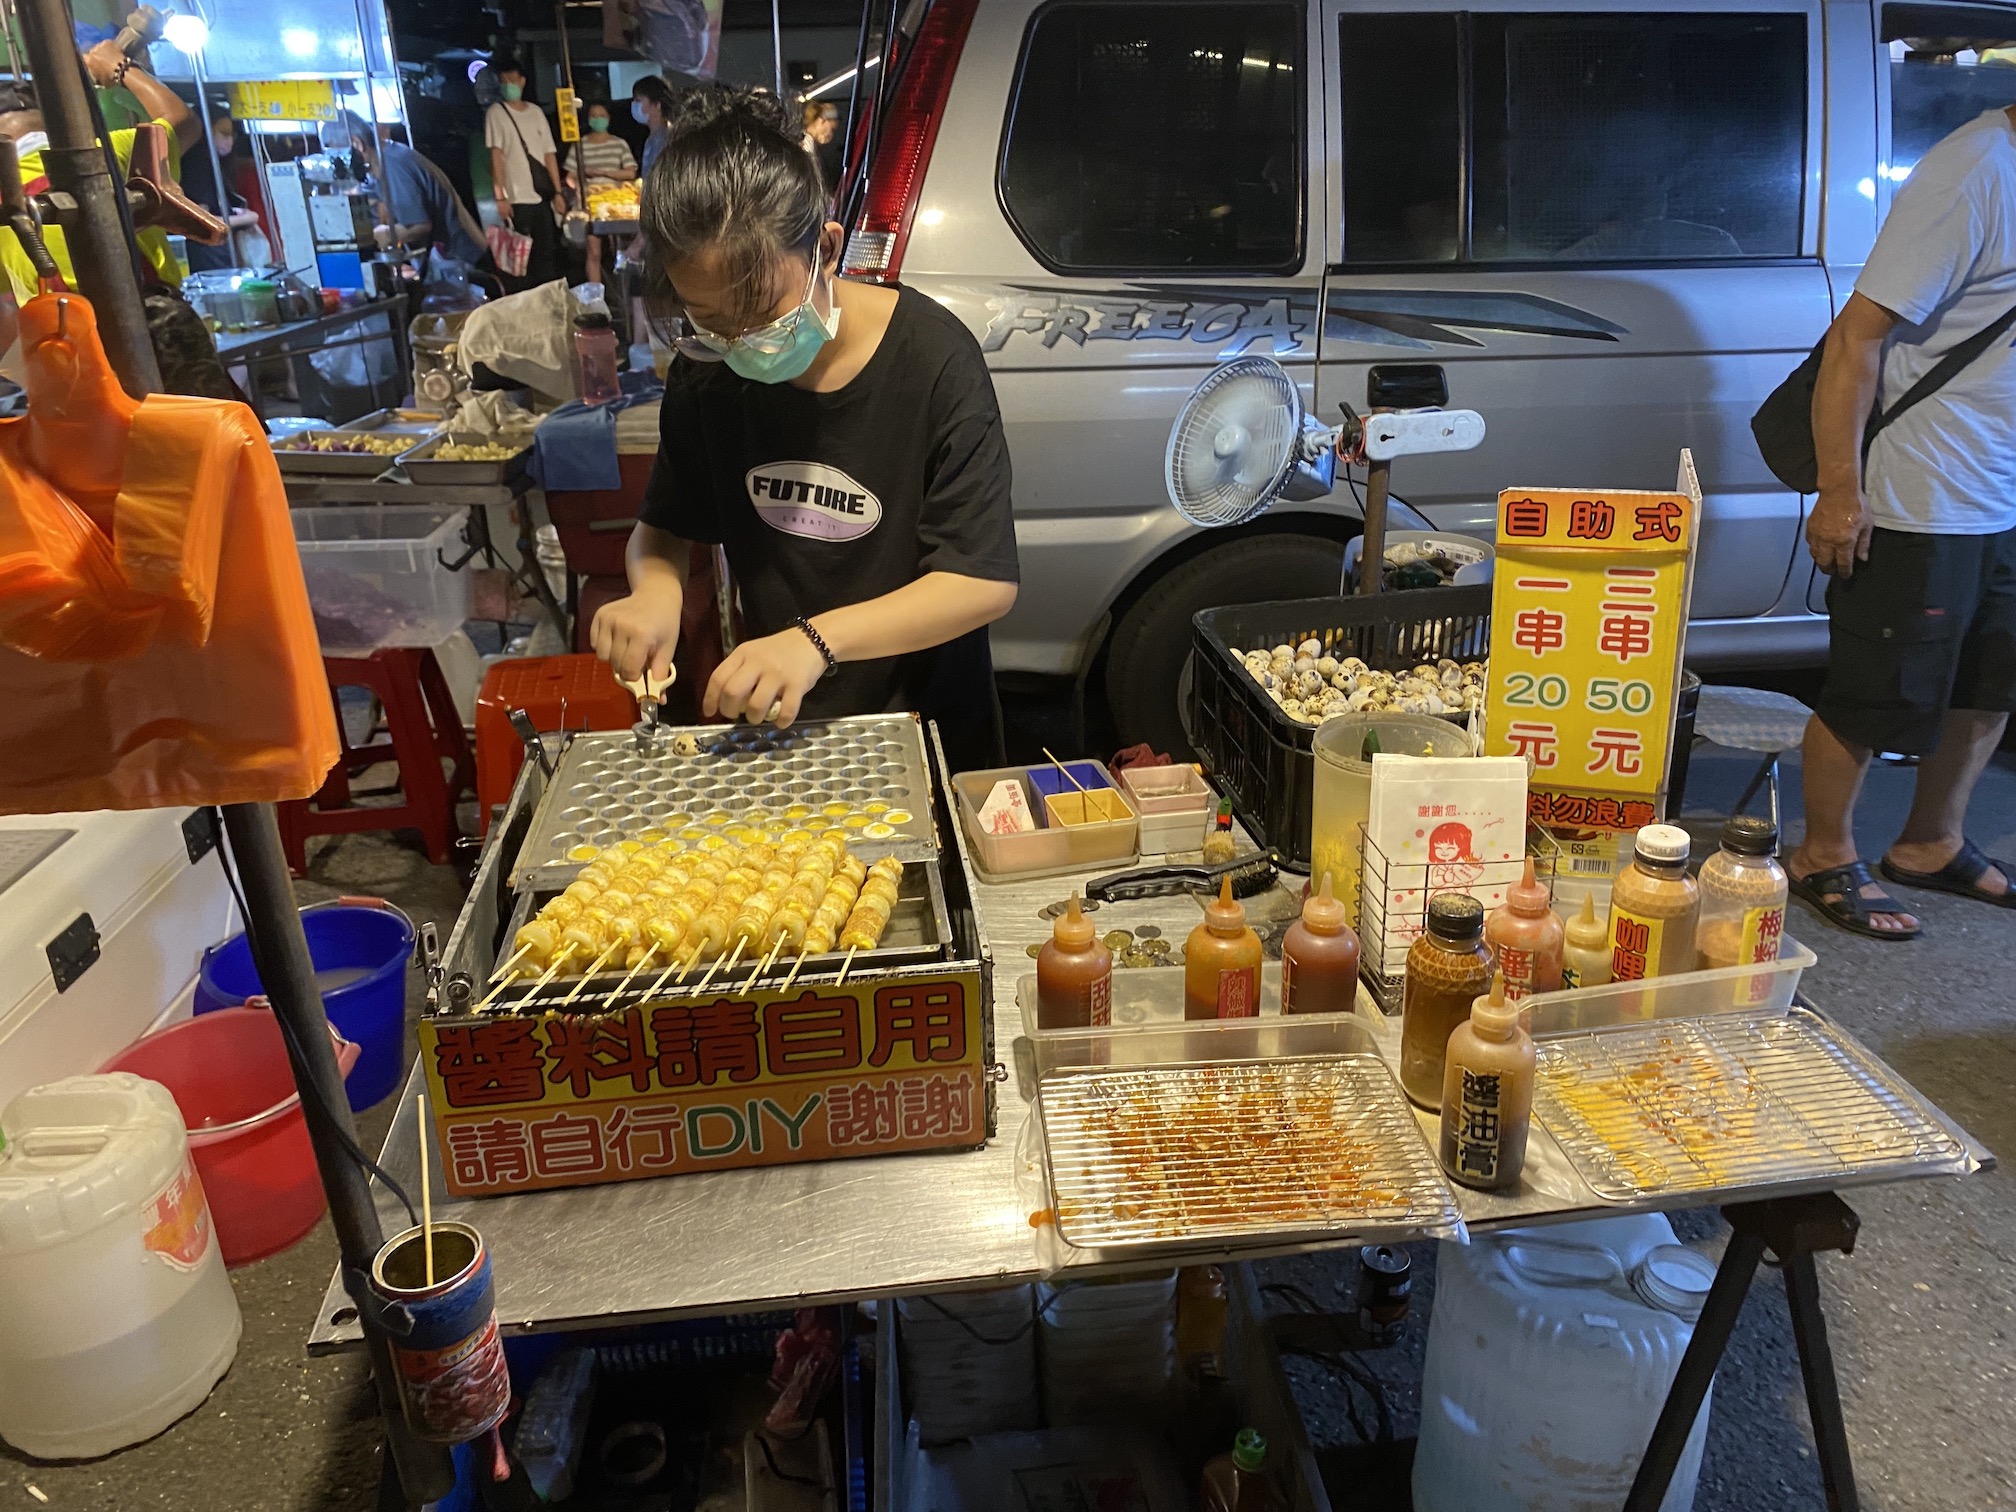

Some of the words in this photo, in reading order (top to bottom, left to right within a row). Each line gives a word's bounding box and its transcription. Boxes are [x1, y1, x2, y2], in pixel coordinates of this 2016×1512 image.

[981, 296, 1307, 360] FREECA
[753, 475, 866, 515] FUTURE
[1506, 499, 1682, 542] 自助式
[434, 981, 967, 1109] 醬料請自用
